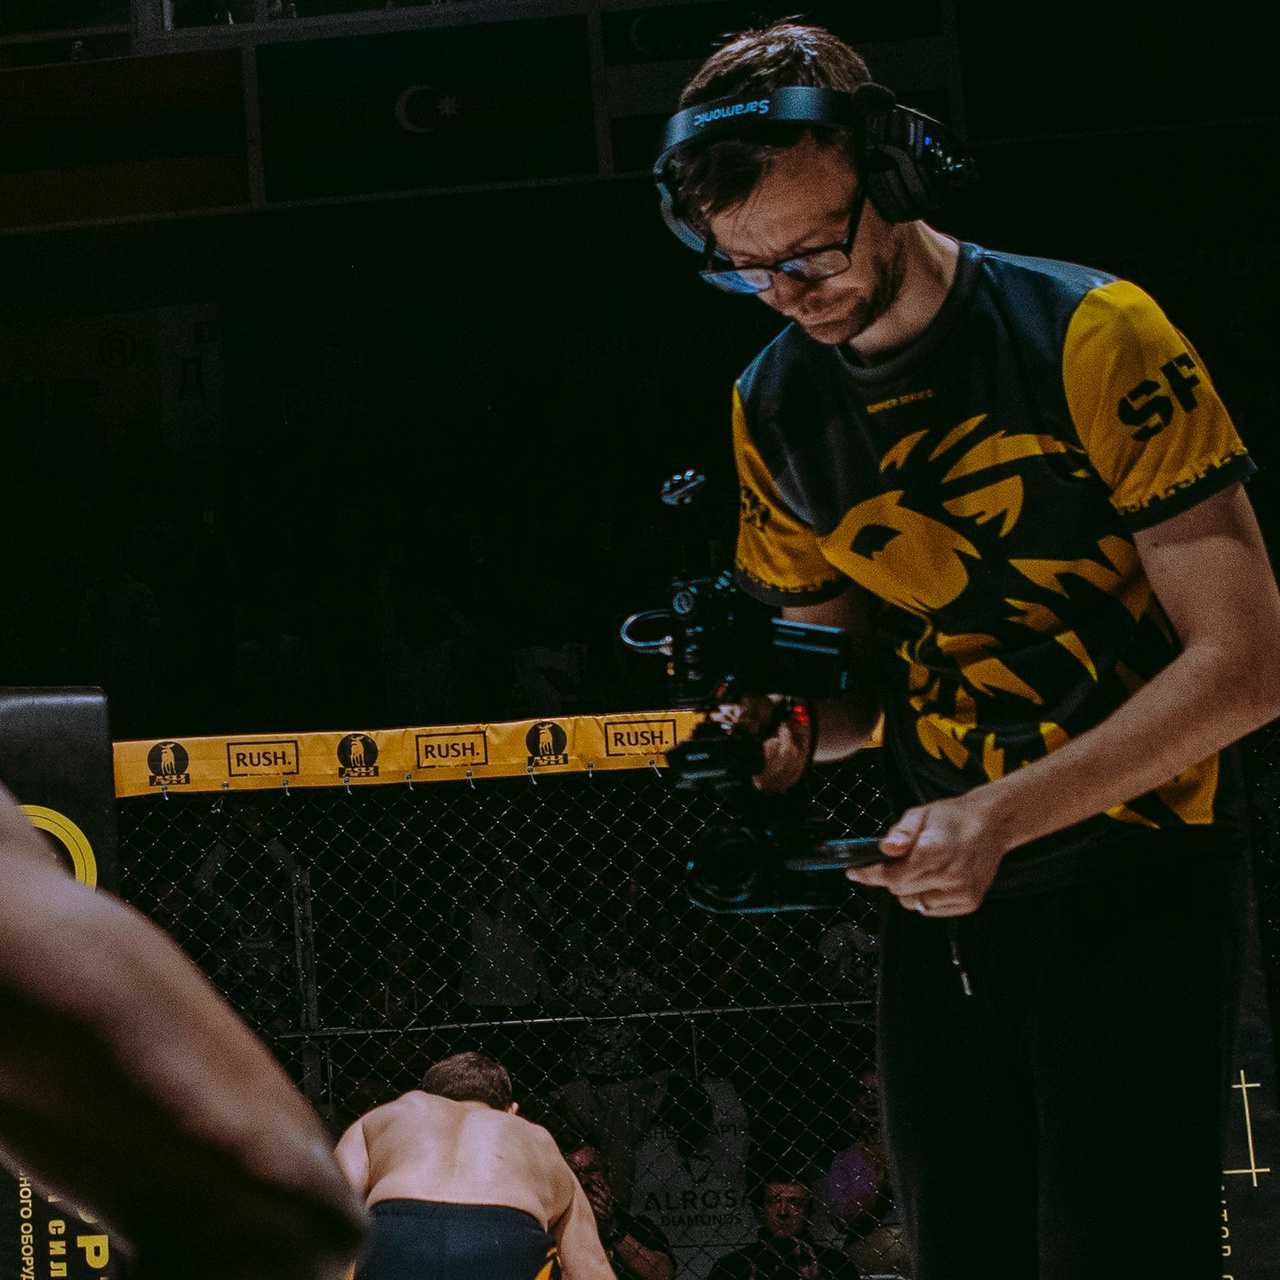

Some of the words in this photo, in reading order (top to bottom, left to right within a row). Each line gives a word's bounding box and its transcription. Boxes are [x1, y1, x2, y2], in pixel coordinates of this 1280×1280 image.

[693, 98, 770, 127] Saramonic
[1117, 352, 1201, 442] SF
[613, 728, 669, 748] RUSH.
[236, 751, 292, 767] RUSH.
[425, 740, 480, 760] RUSH.
[18, 1171, 33, 1220] НОГО
[660, 1213, 742, 1227] DIAMONDS
